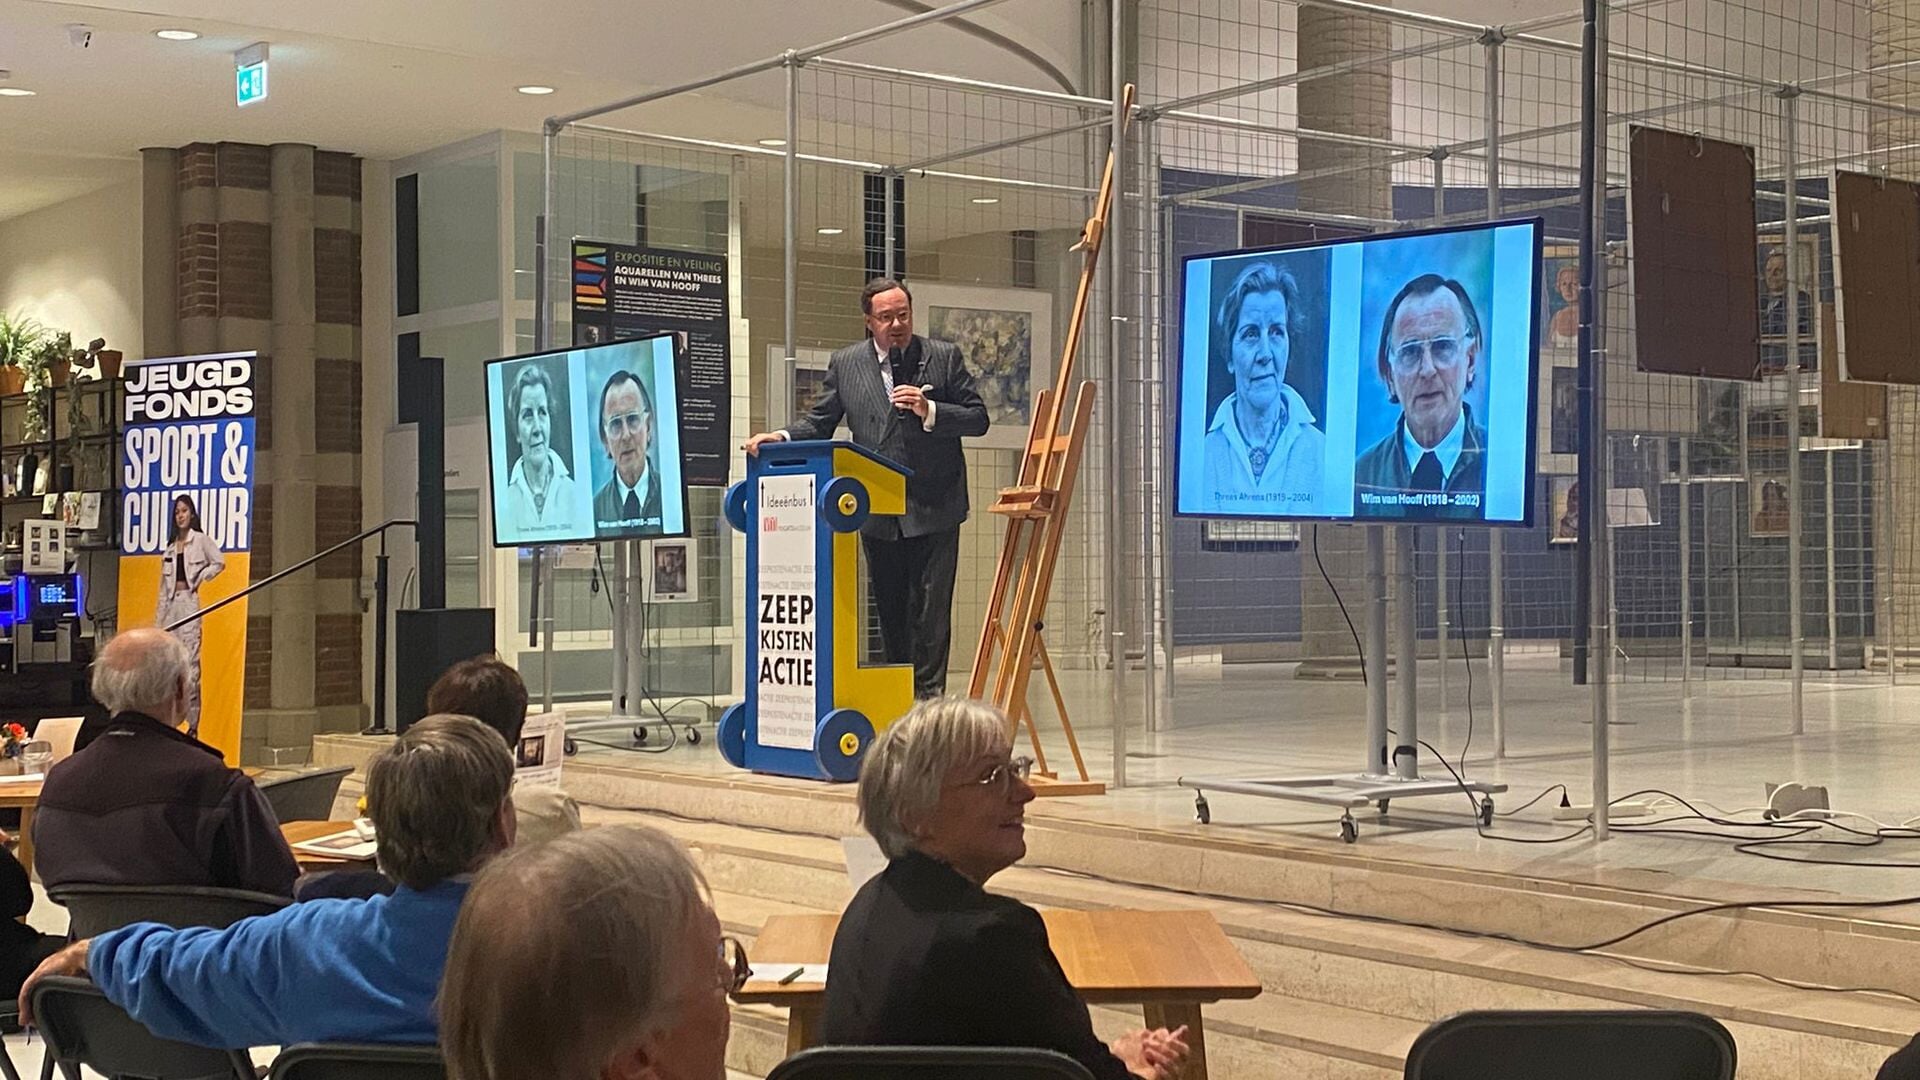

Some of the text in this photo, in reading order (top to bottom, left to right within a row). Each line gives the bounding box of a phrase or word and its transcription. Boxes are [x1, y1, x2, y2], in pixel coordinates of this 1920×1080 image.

[614, 252, 722, 272] EXPOSITIE EN VEILING
[614, 266, 722, 284] AQUARELLEN VAN THREES
[614, 276, 701, 292] EN WIM VAN HOOFF
[125, 359, 251, 393] JEUGD
[125, 387, 254, 421] FONDS
[125, 421, 249, 489] SPORT &
[1361, 493, 1381, 504] Wim
[1381, 495, 1398, 504] van
[1398, 493, 1423, 505] Hooff
[1423, 493, 1448, 507] (1918
[1455, 494, 1480, 508] 2002)
[123, 487, 249, 553] CULUUR
[761, 594, 814, 625] ZEEP
[761, 630, 813, 651] KISTEN
[759, 657, 813, 686] ACTIE
